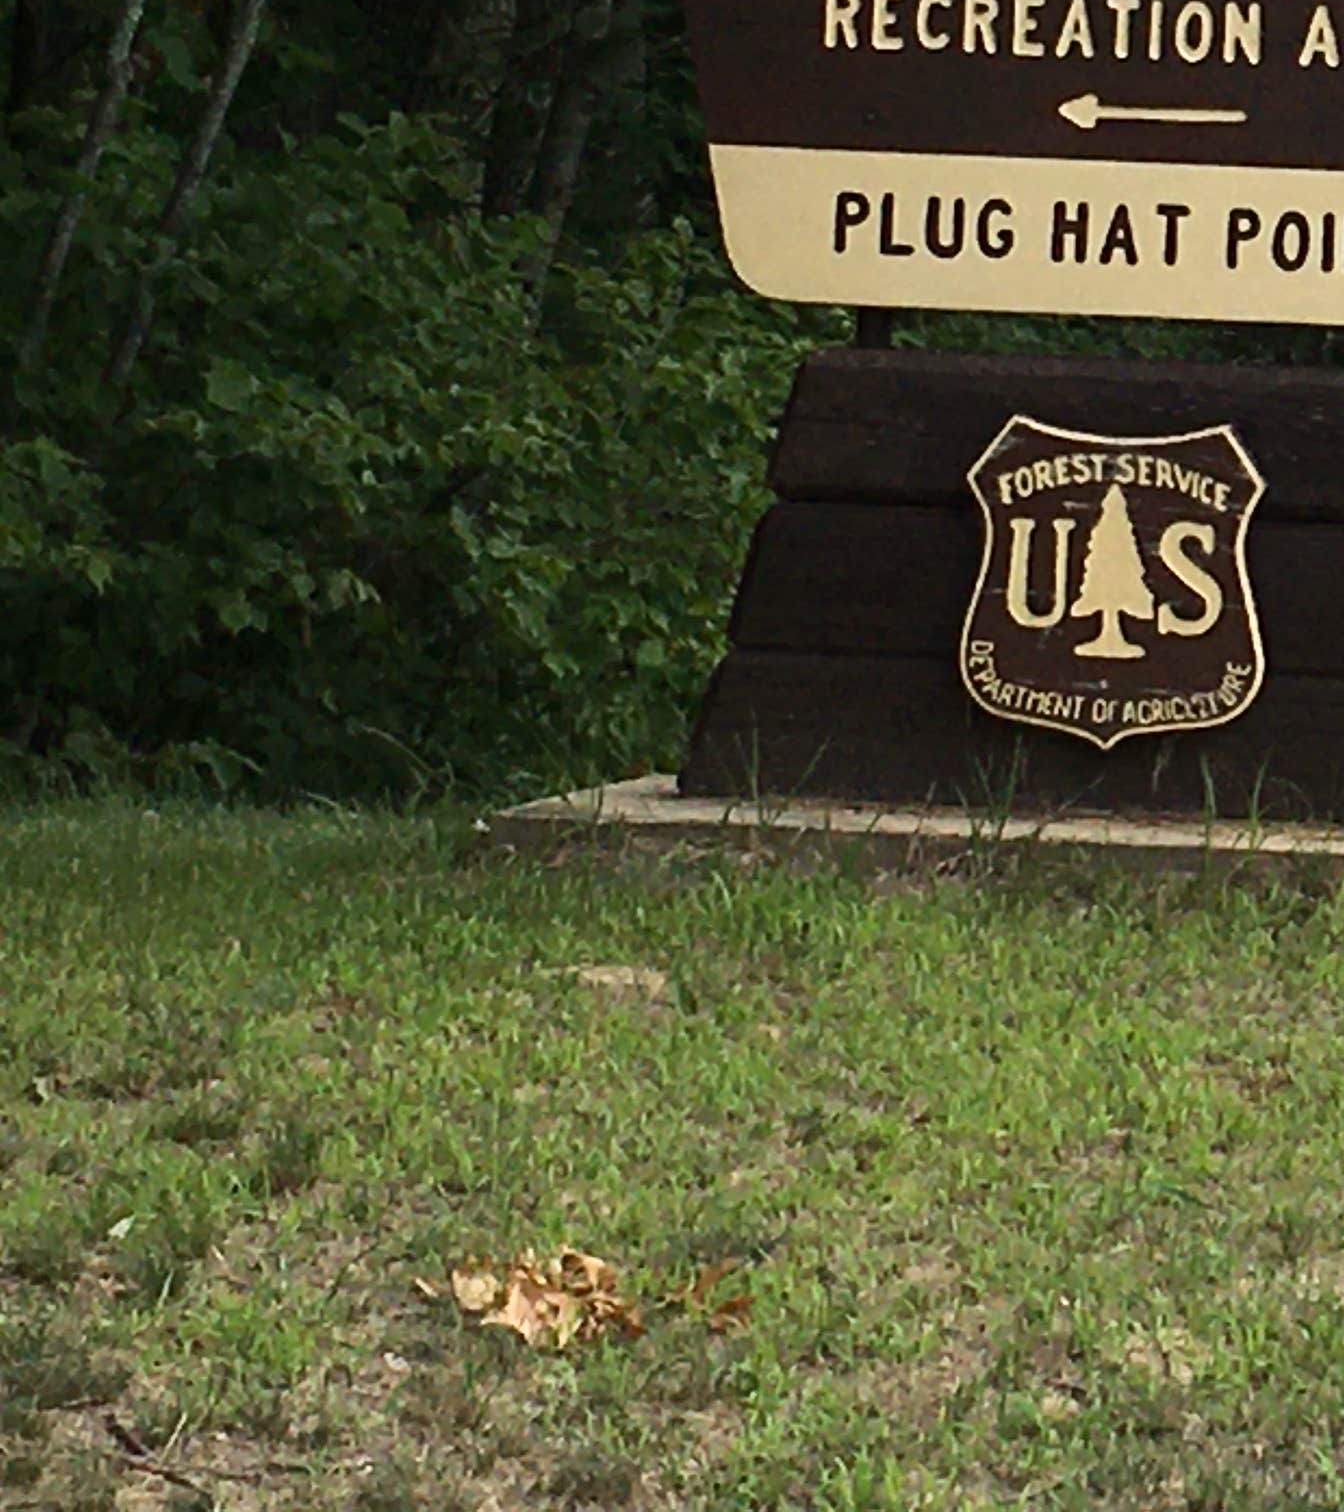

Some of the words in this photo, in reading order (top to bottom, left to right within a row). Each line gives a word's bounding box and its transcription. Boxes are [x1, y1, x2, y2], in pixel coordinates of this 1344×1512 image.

[833, 191, 1015, 259] PLUG
[1050, 200, 1192, 266] HAT
[998, 453, 1106, 505] FOREST
[1118, 452, 1231, 513] SERVICE
[969, 639, 1084, 720] DEPARTMENT
